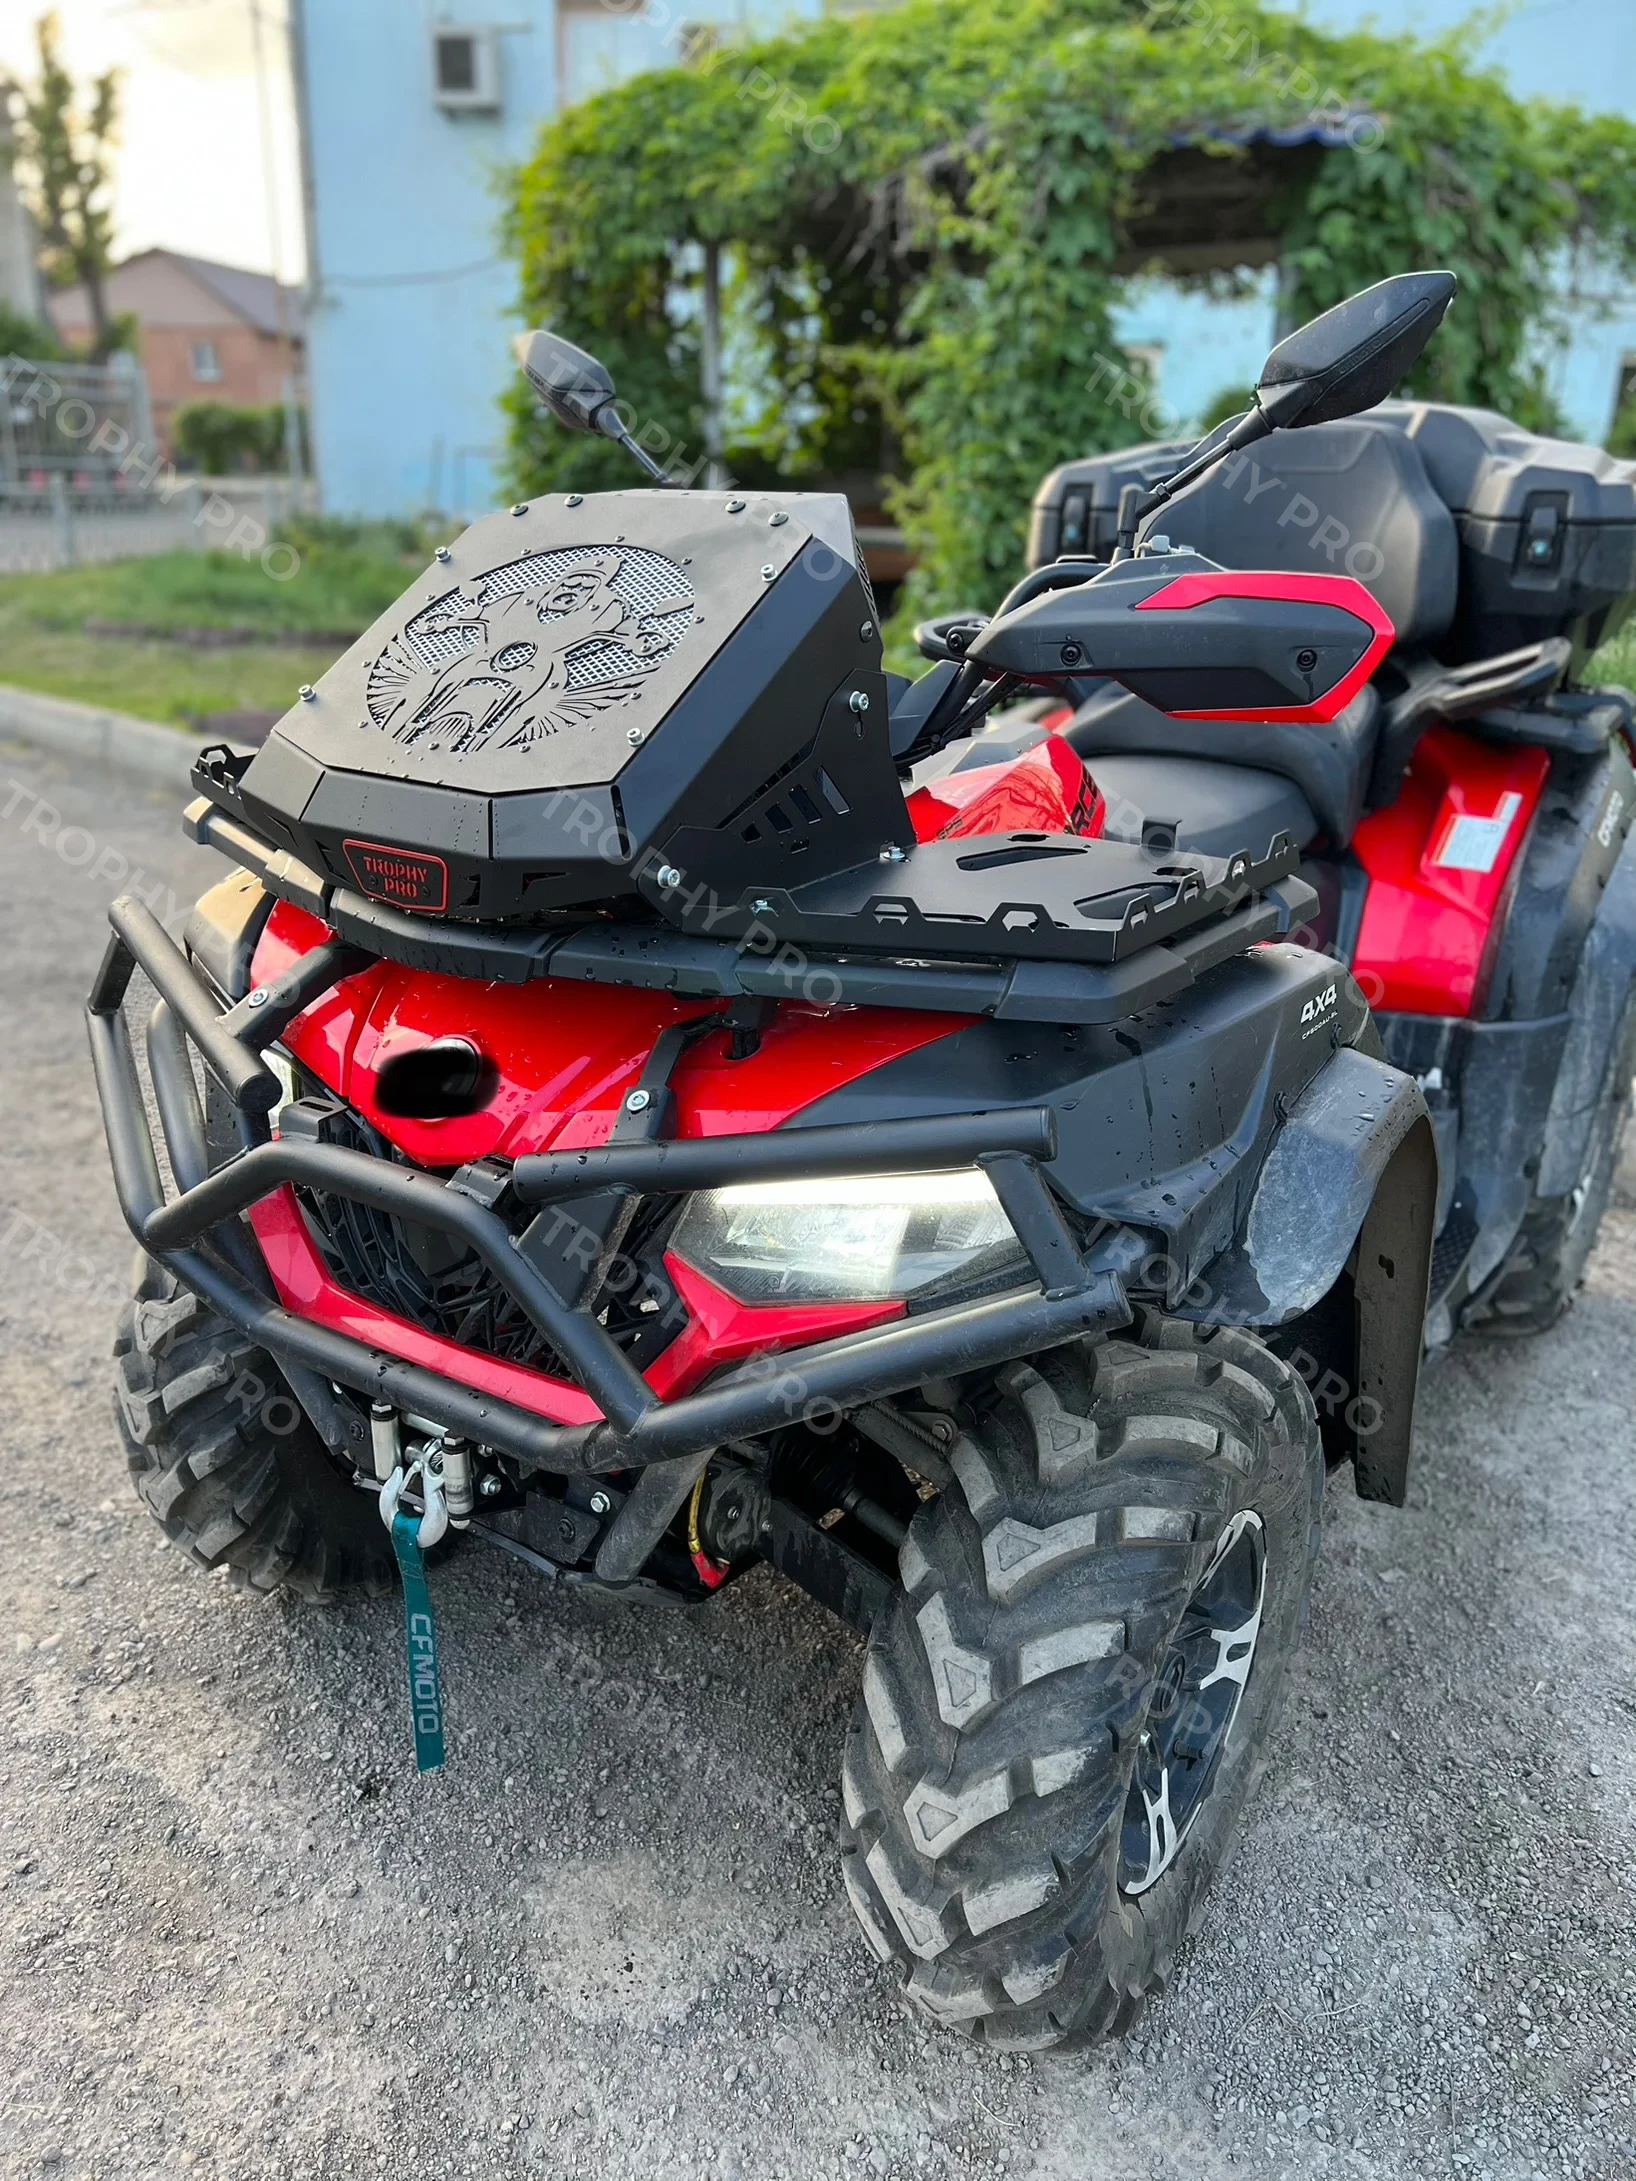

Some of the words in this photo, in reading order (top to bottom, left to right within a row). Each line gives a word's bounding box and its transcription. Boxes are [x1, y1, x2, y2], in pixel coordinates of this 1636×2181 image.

[363, 856, 427, 883] TROPHY
[383, 877, 418, 898] PRO
[410, 1612, 440, 1734] CFMOTO
